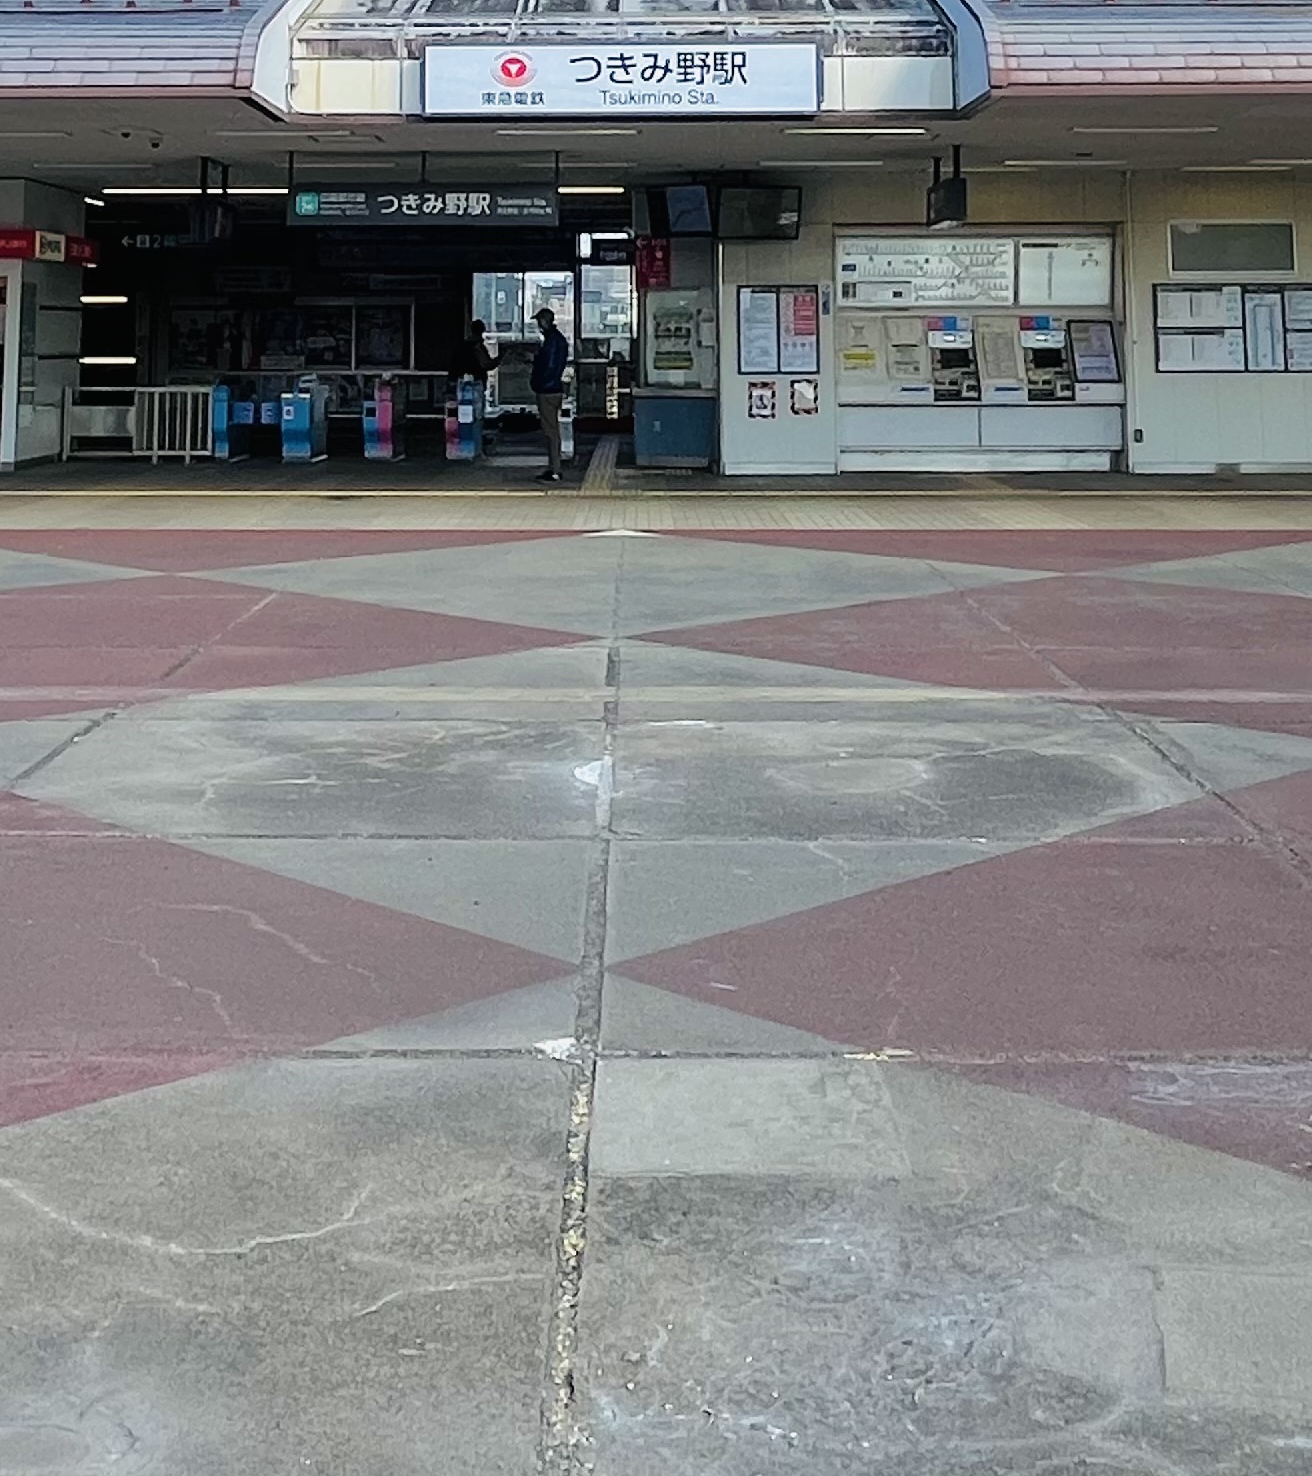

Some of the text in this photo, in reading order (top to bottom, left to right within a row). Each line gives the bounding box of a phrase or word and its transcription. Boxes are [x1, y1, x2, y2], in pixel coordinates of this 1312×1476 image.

[569, 52, 747, 85] つきみ野駅
[481, 91, 545, 106] 東急電鉄
[600, 89, 719, 105] Tsukimino Sta.
[377, 192, 491, 215] つきみ野駅
